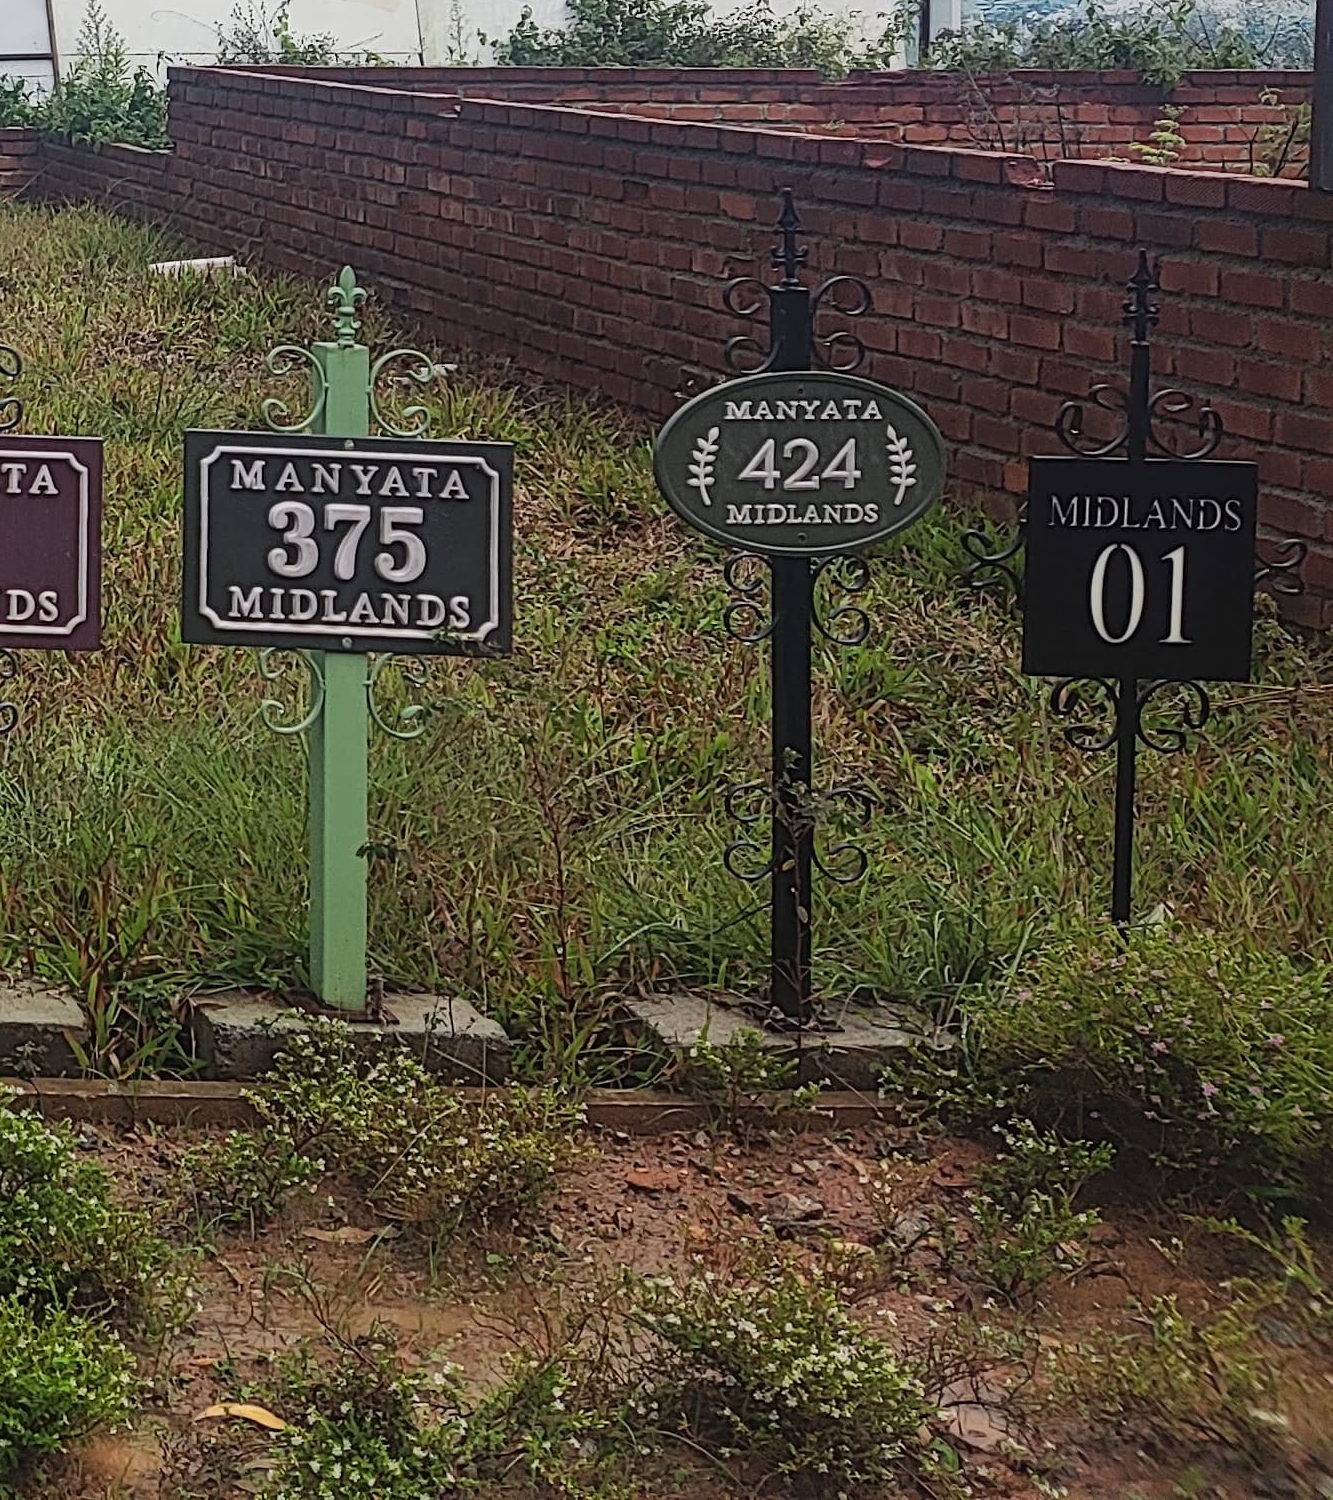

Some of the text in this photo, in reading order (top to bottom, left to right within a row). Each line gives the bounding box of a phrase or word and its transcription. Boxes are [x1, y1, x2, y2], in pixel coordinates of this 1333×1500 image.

[724, 400, 883, 420] MANYATA
[230, 459, 470, 500] MANYATA
[737, 437, 861, 490] 424
[725, 504, 879, 524] MIDLANDS
[1048, 495, 1242, 532] MIDLANDS
[267, 500, 427, 584] 375
[227, 586, 471, 628] MIDLANDS
[1090, 543, 1193, 643] 01
